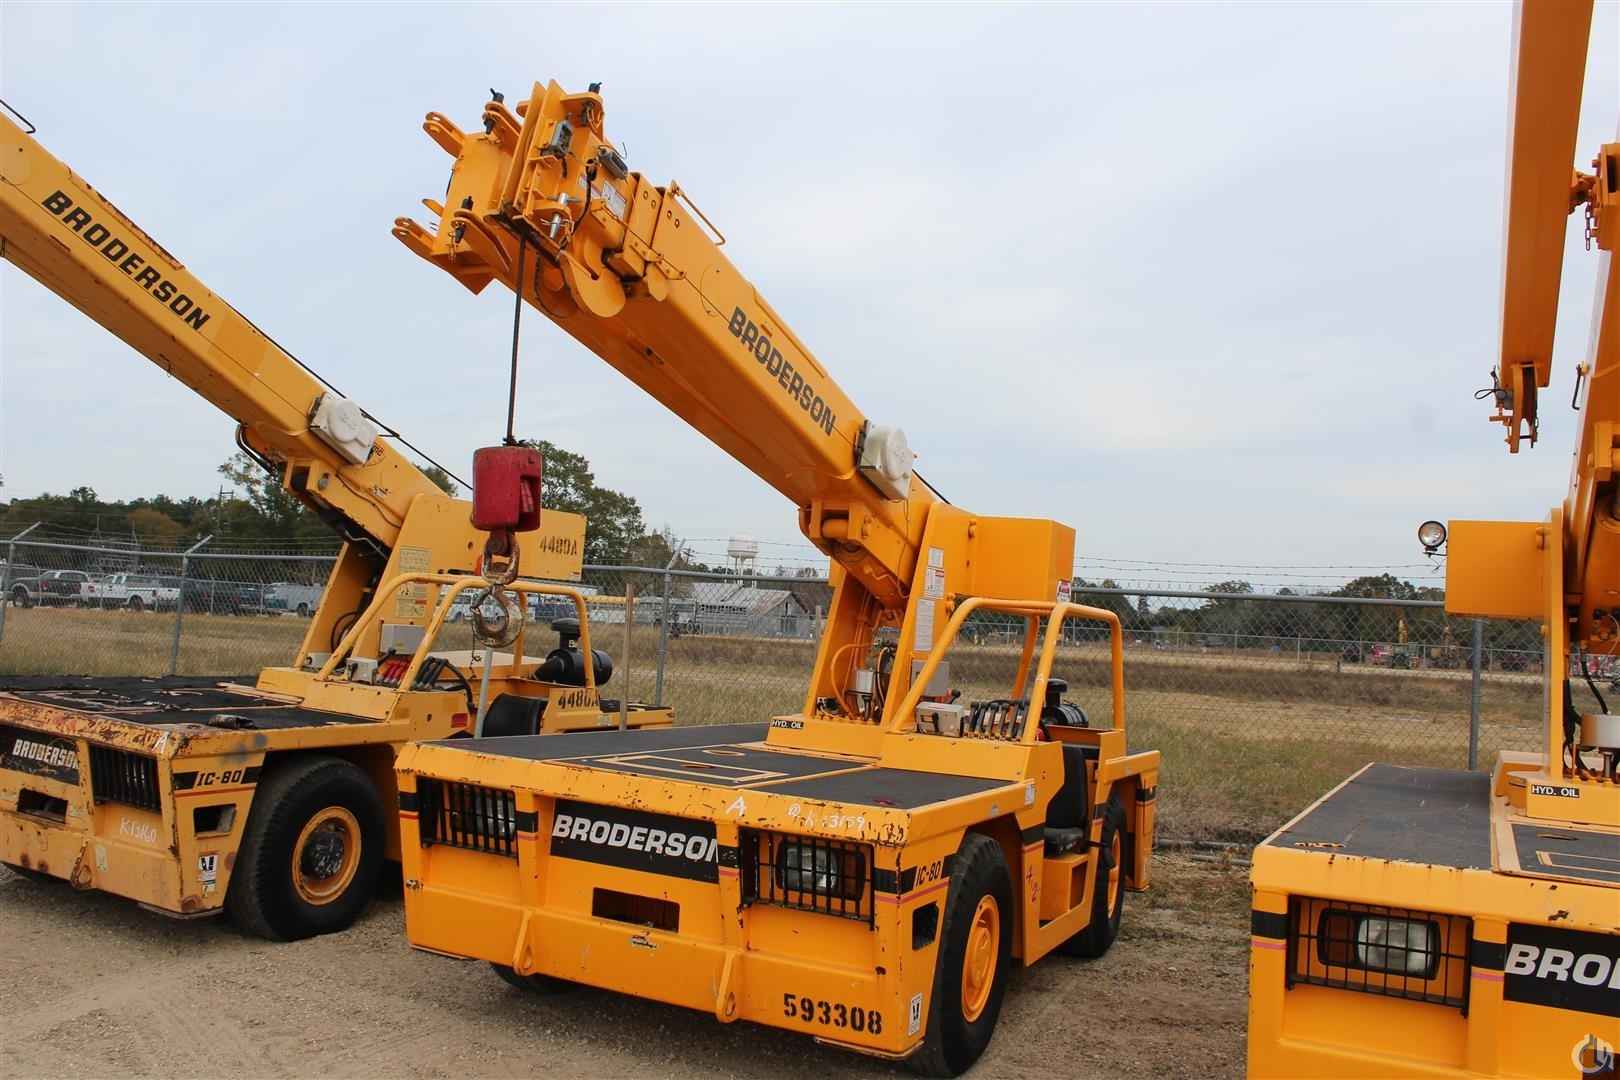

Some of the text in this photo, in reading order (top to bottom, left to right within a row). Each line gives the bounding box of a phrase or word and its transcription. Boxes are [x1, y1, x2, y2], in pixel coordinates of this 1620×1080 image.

[41, 190, 210, 330] BRODERSON
[728, 306, 836, 436] BRODERSON
[197, 770, 242, 786] IC-80
[1532, 785, 1579, 798] HYD. OIL
[726, 796, 747, 817] A
[916, 860, 942, 887] IC-80
[783, 993, 882, 1035] 593308
